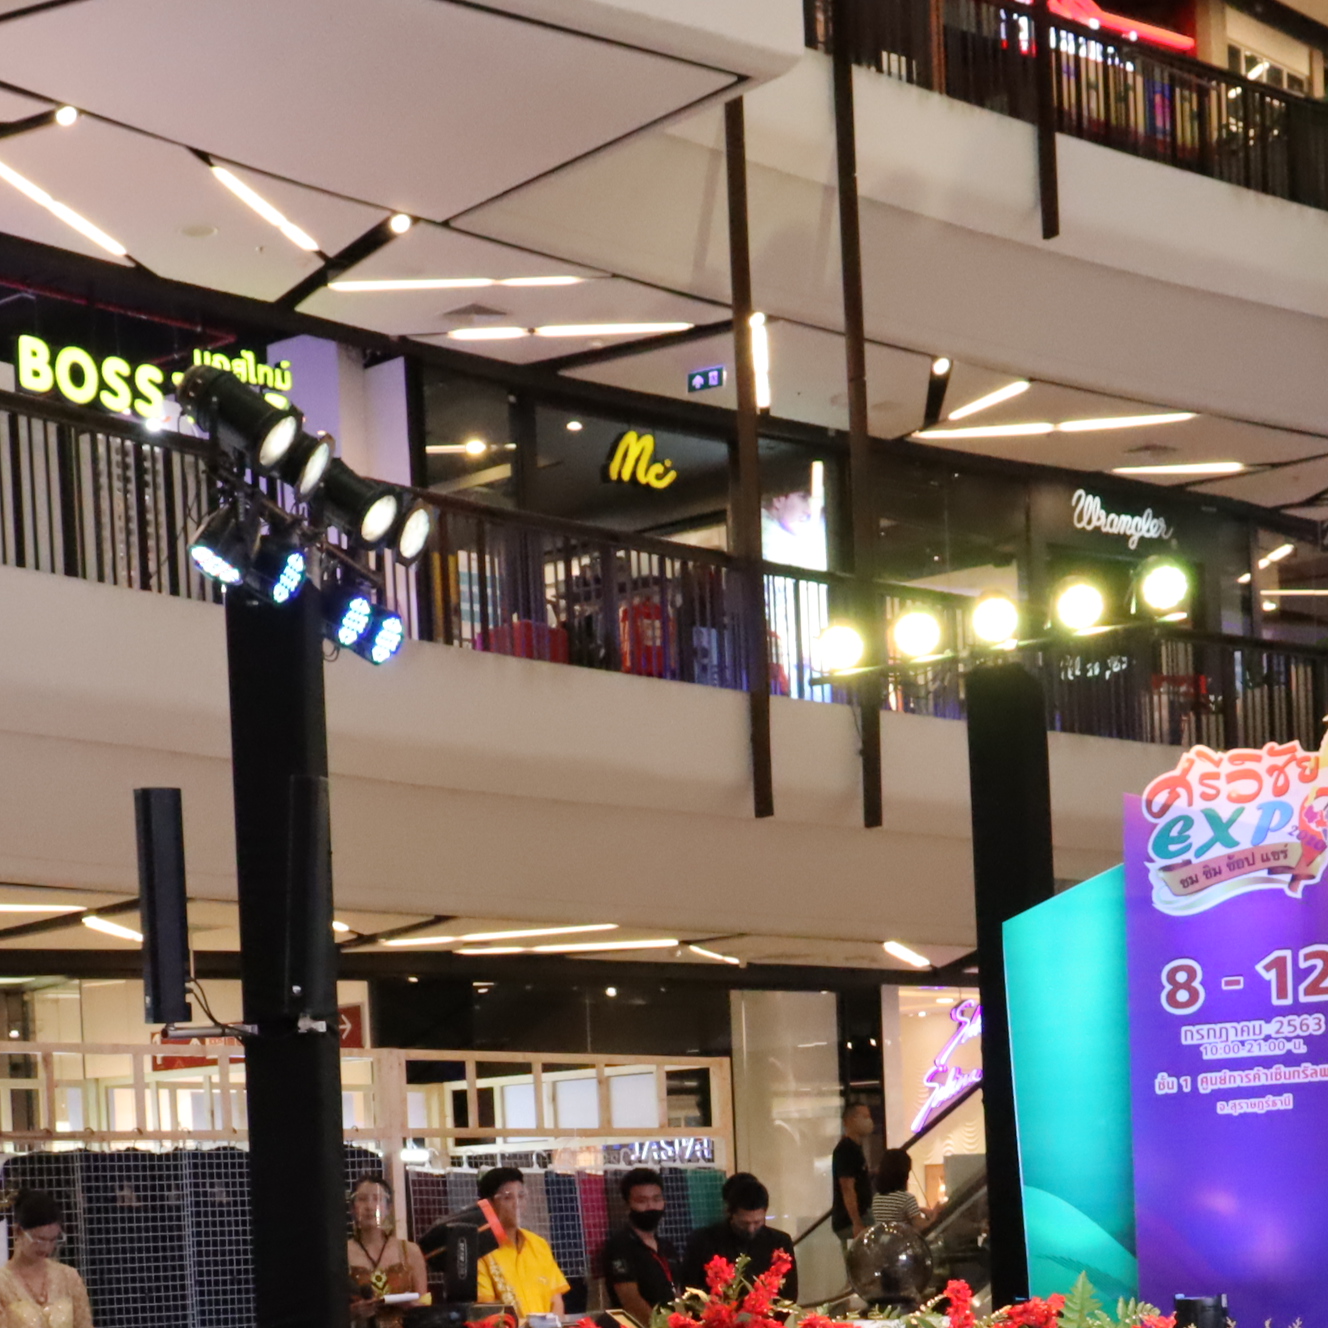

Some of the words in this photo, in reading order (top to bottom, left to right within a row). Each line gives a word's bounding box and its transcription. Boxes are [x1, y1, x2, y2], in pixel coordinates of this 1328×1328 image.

[17, 334, 165, 420] BOSS
[1071, 488, 1174, 550] Wrangler
[1145, 744, 1321, 819] ศรีวิชัย
[1163, 960, 1203, 1013] 8
[1183, 1022, 1264, 1043] กรกฎาคม
[1274, 1016, 1324, 1035] 2563
[1157, 1073, 1176, 1092] ชั้น
[1180, 1079, 1190, 1091] 1
